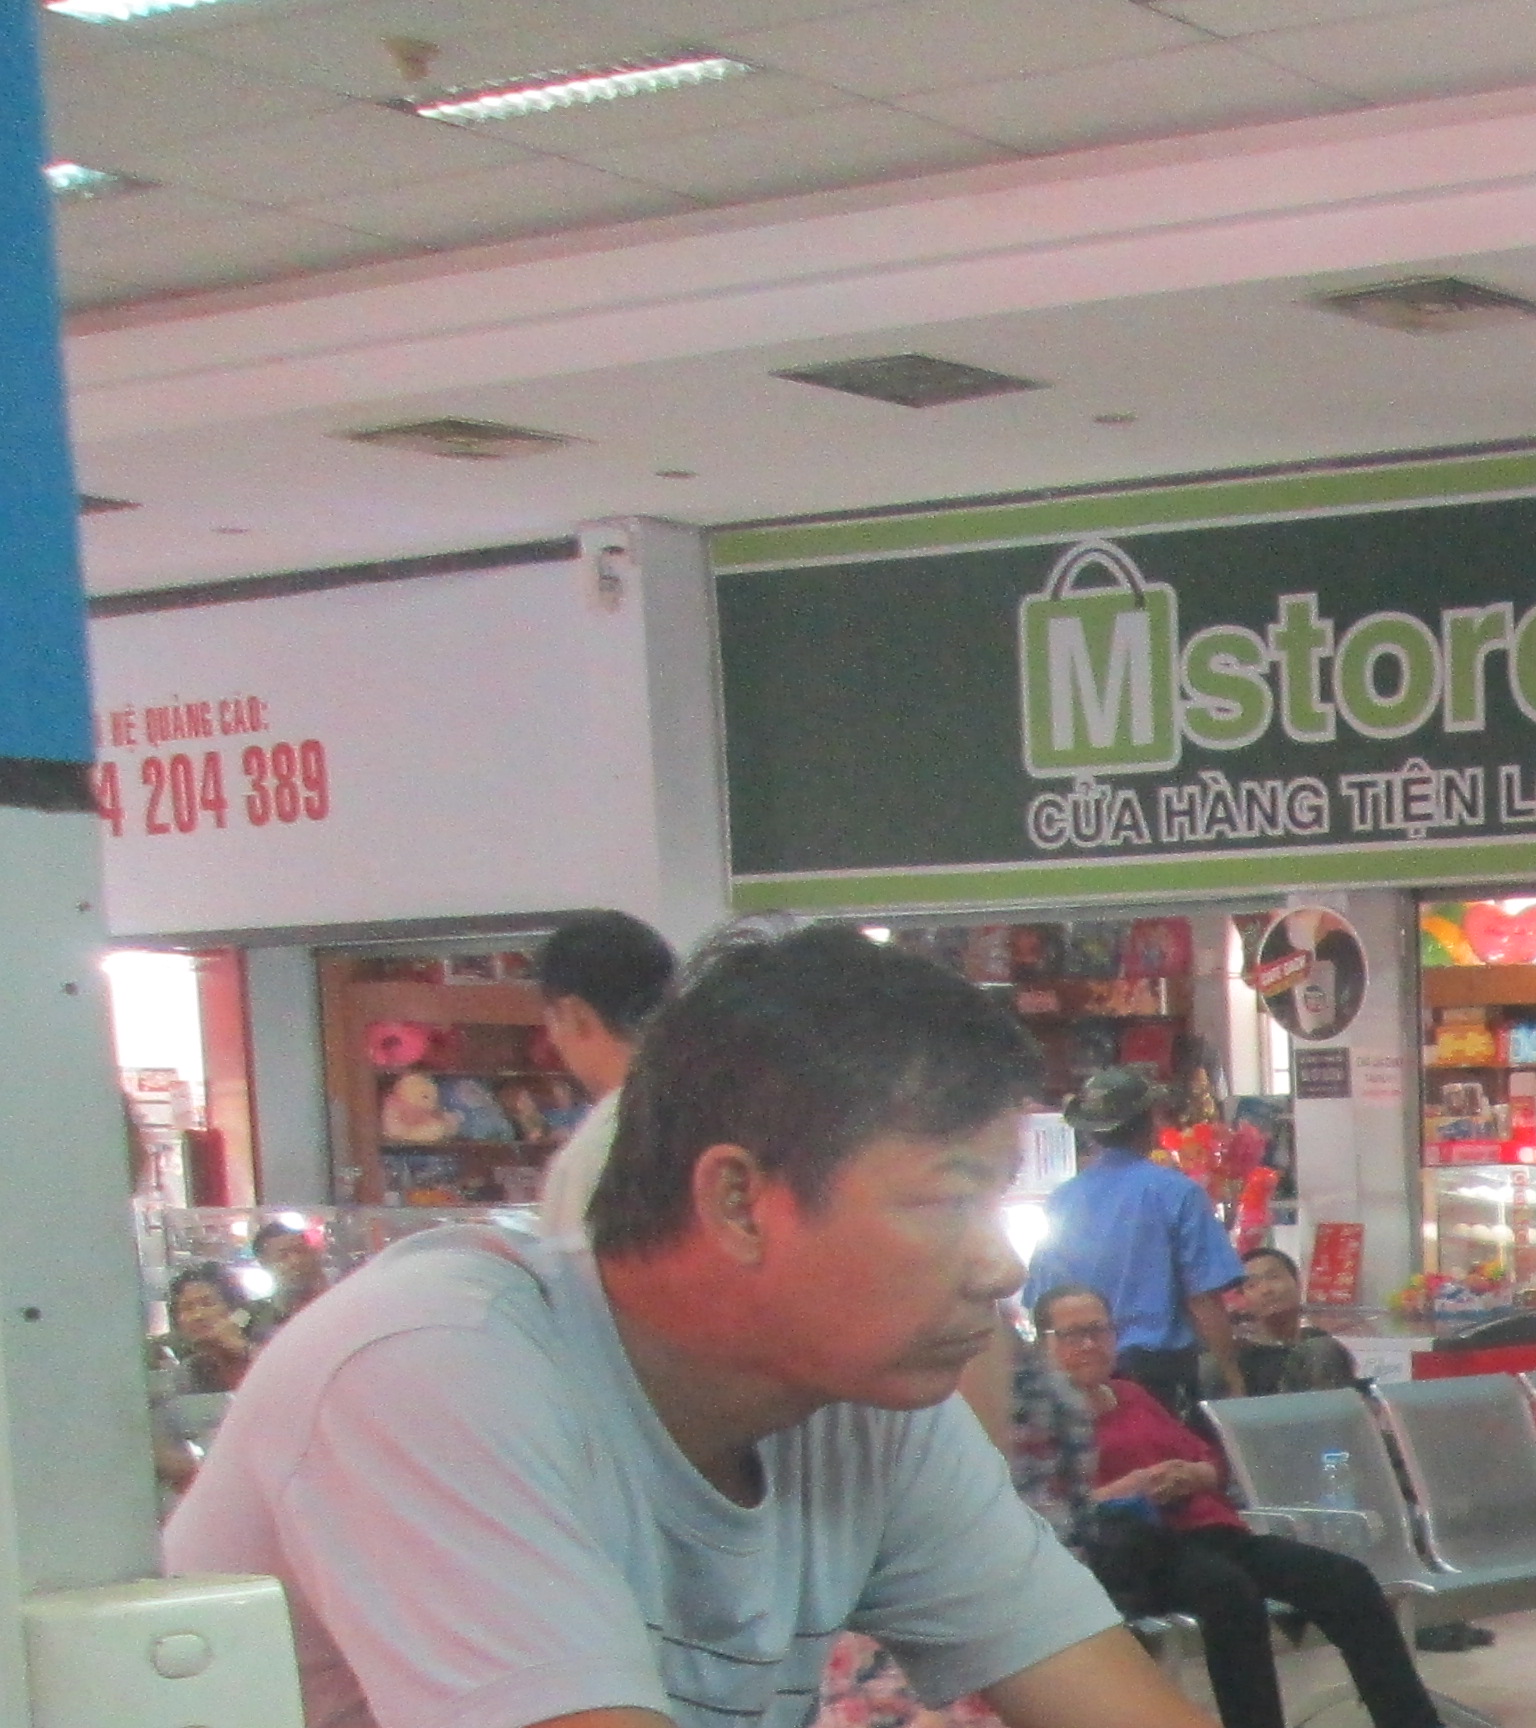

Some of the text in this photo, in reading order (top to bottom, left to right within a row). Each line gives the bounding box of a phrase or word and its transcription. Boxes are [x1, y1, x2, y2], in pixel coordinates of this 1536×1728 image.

[142, 751, 229, 836] 204
[243, 739, 329, 827] 389
[1028, 770, 1151, 850] CỬA
[1158, 769, 1330, 841] HÀNG
[1340, 756, 1484, 839] TIỆN
